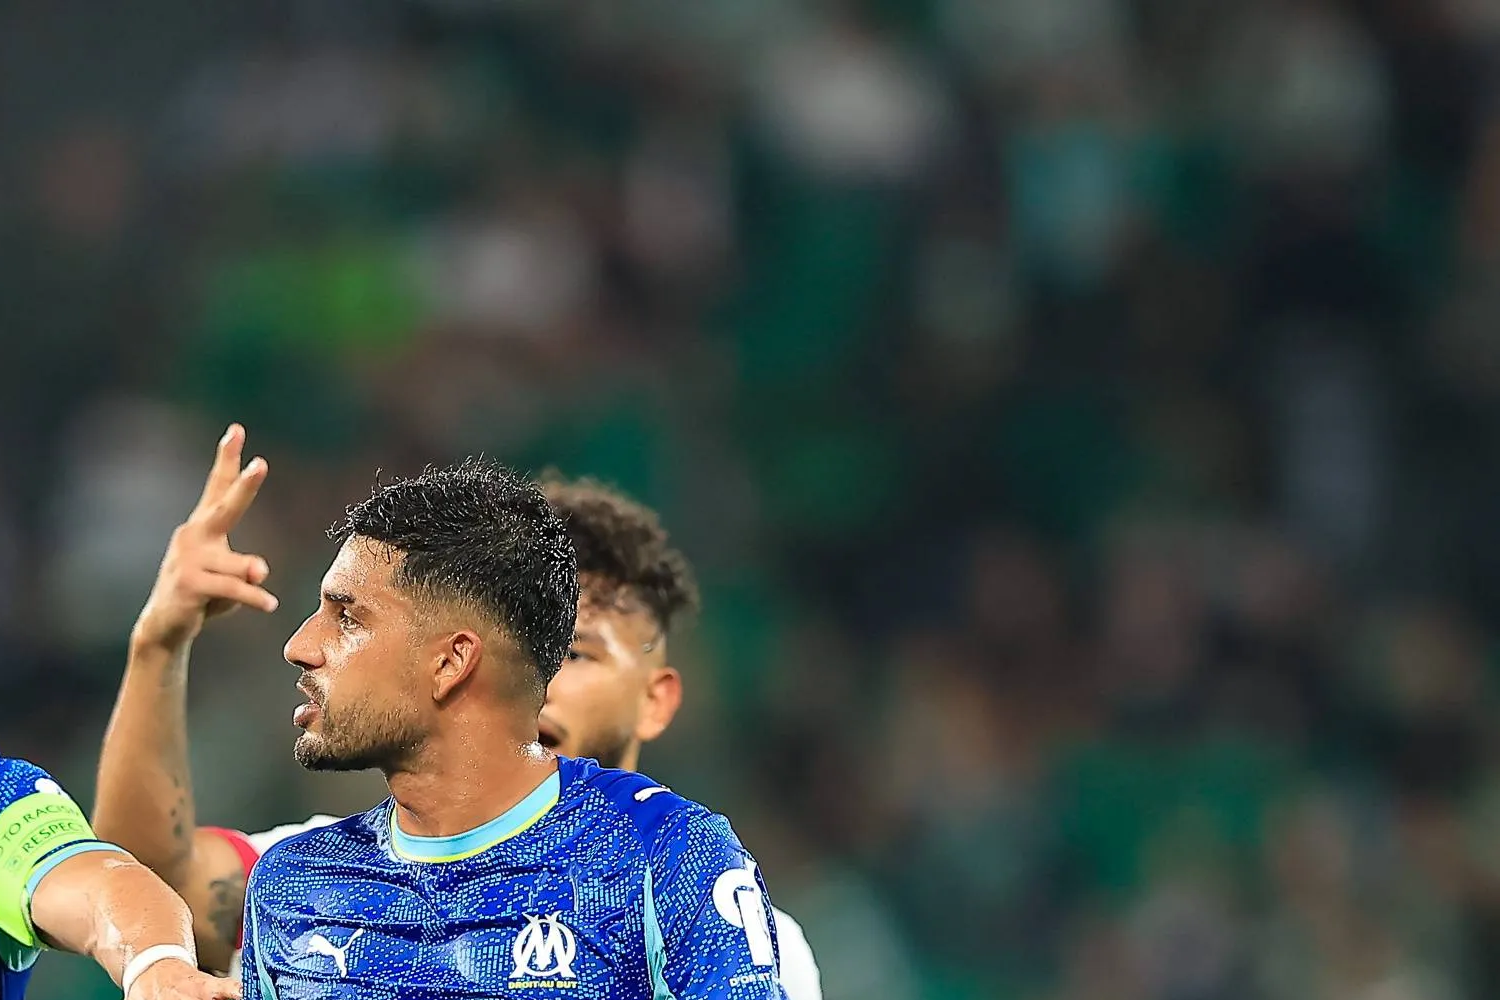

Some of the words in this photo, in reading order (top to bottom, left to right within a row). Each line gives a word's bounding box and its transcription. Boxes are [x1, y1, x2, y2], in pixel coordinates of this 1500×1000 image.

[2, 822, 21, 842] TO
[508, 980, 539, 990] DROIT
[539, 980, 555, 989] AU
[556, 980, 578, 989] BUT
